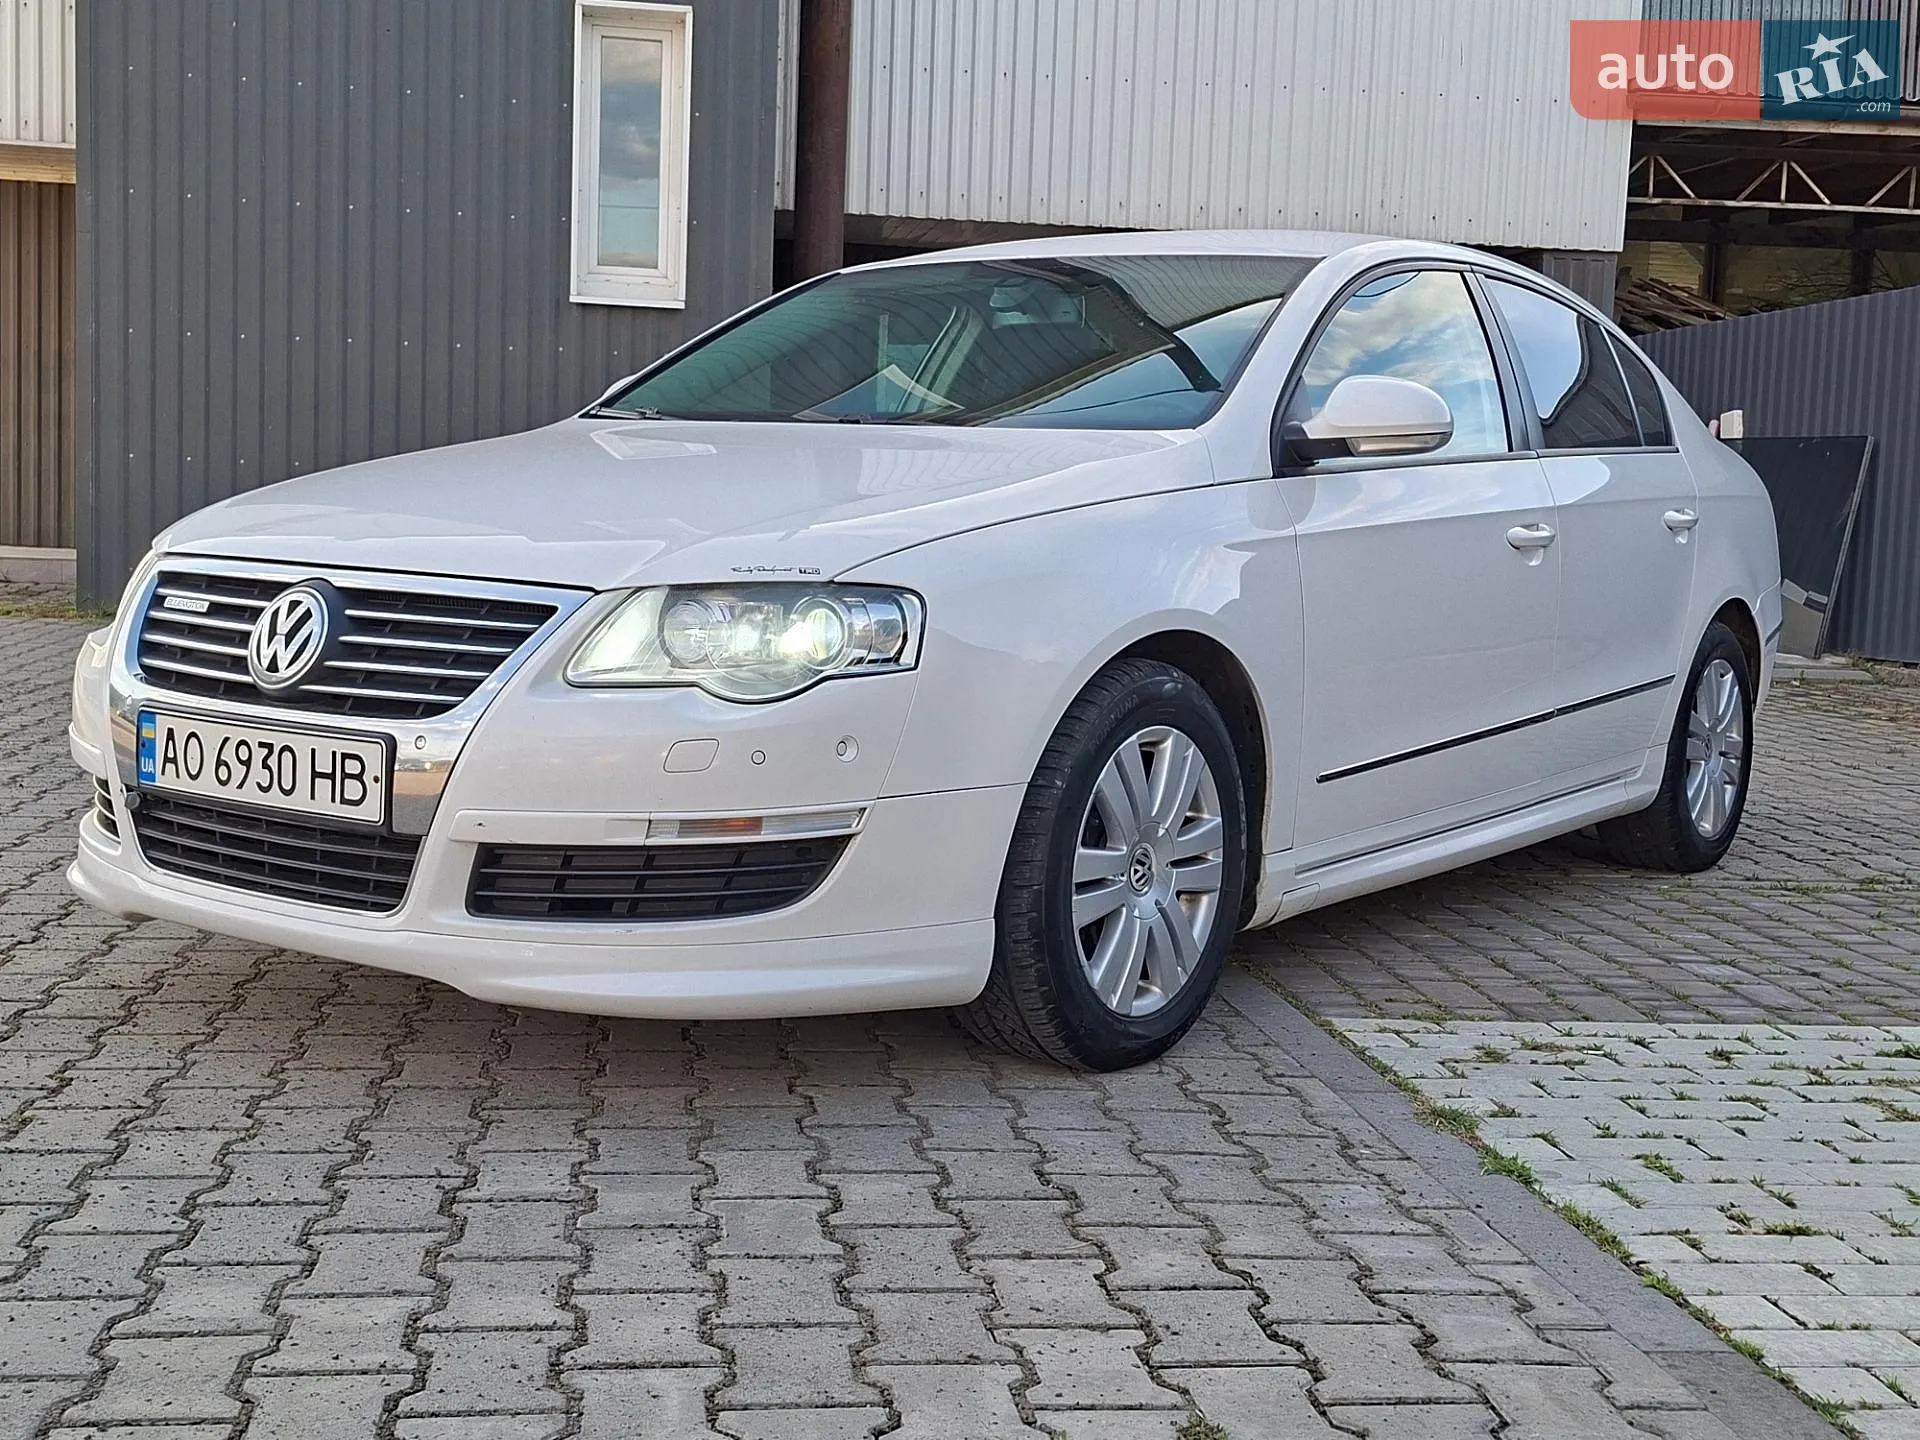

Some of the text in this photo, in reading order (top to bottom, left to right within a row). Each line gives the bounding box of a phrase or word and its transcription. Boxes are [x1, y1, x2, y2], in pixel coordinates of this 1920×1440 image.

[249, 588, 326, 686] VW
[141, 756, 155, 774] UA
[161, 727, 368, 807] AO 6930 HB
